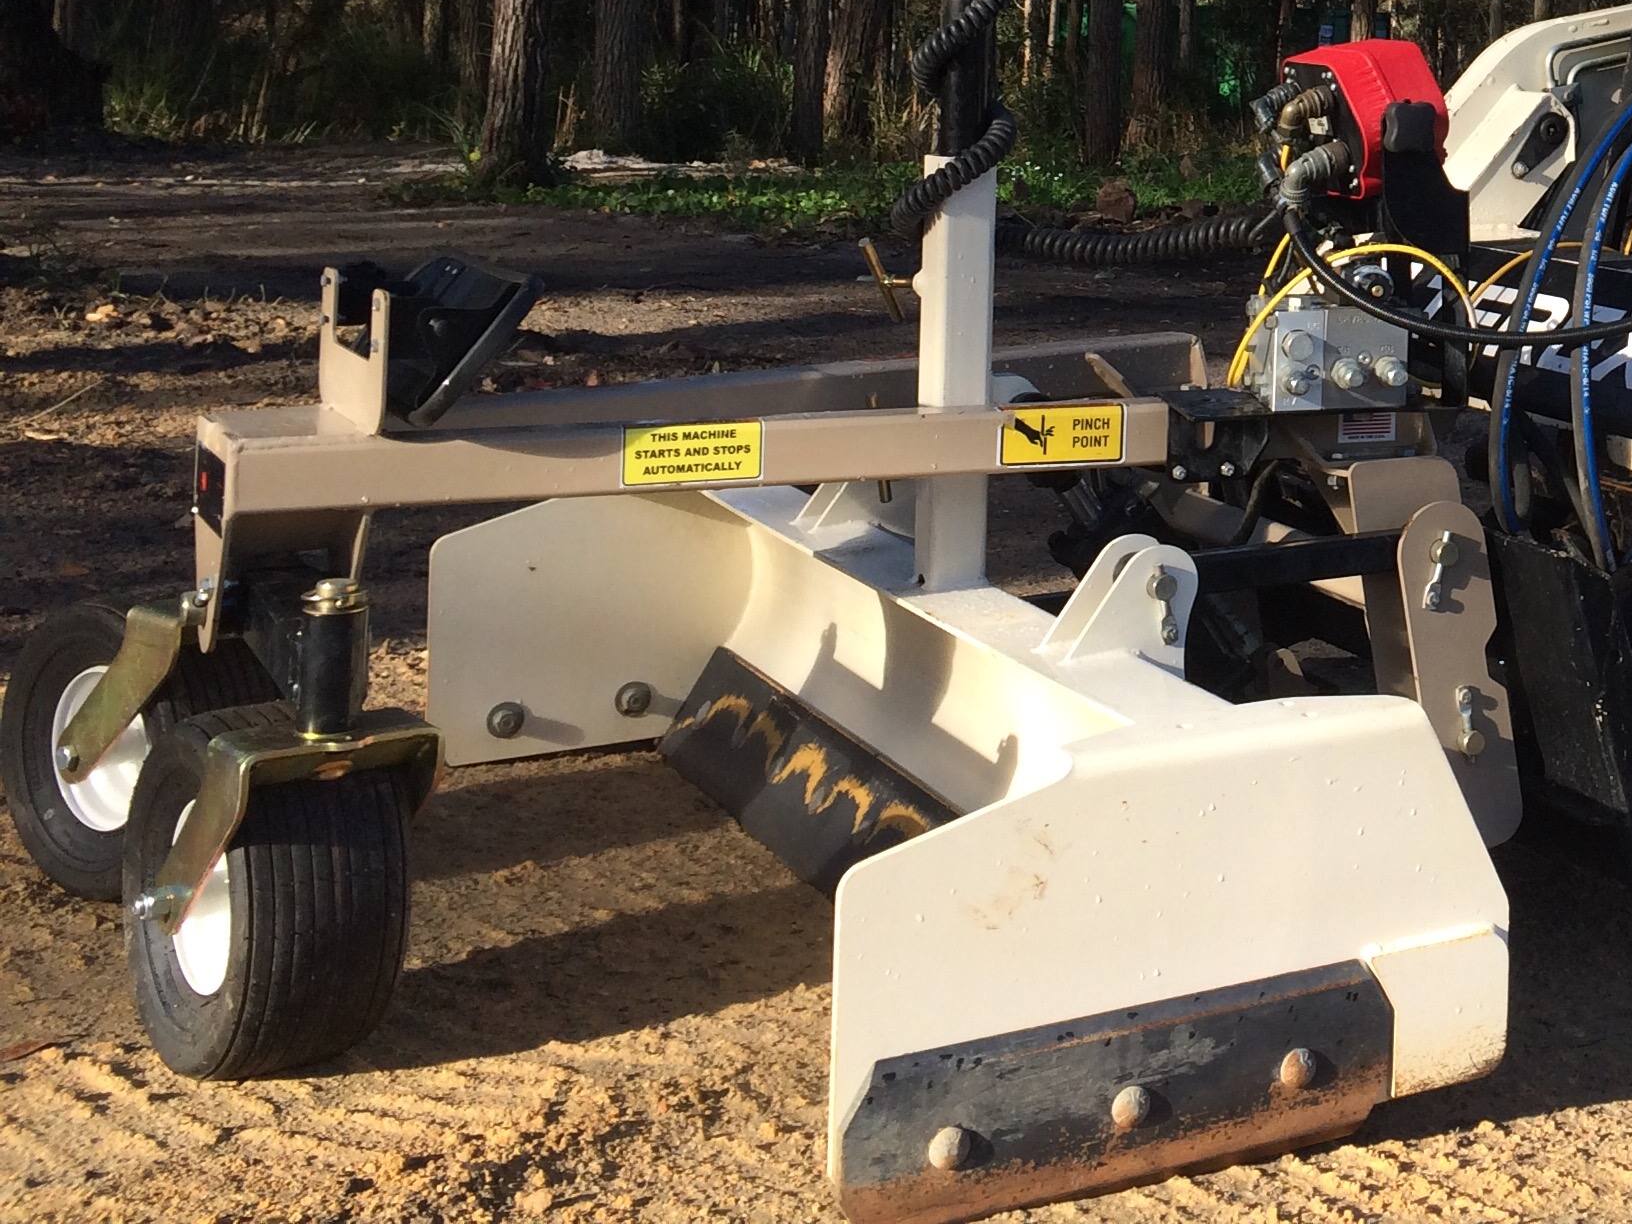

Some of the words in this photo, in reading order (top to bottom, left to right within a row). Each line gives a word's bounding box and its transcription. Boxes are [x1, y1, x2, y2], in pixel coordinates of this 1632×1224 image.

[1072, 418, 1111, 431] PINCH
[650, 432, 679, 442] THIS
[682, 429, 737, 441] MACHINE
[1072, 435, 1110, 448] POINT
[634, 448, 681, 459] STARTS
[684, 447, 710, 457] AND
[713, 444, 751, 456] STOPS
[642, 461, 743, 476] AUTOMATICALLY
